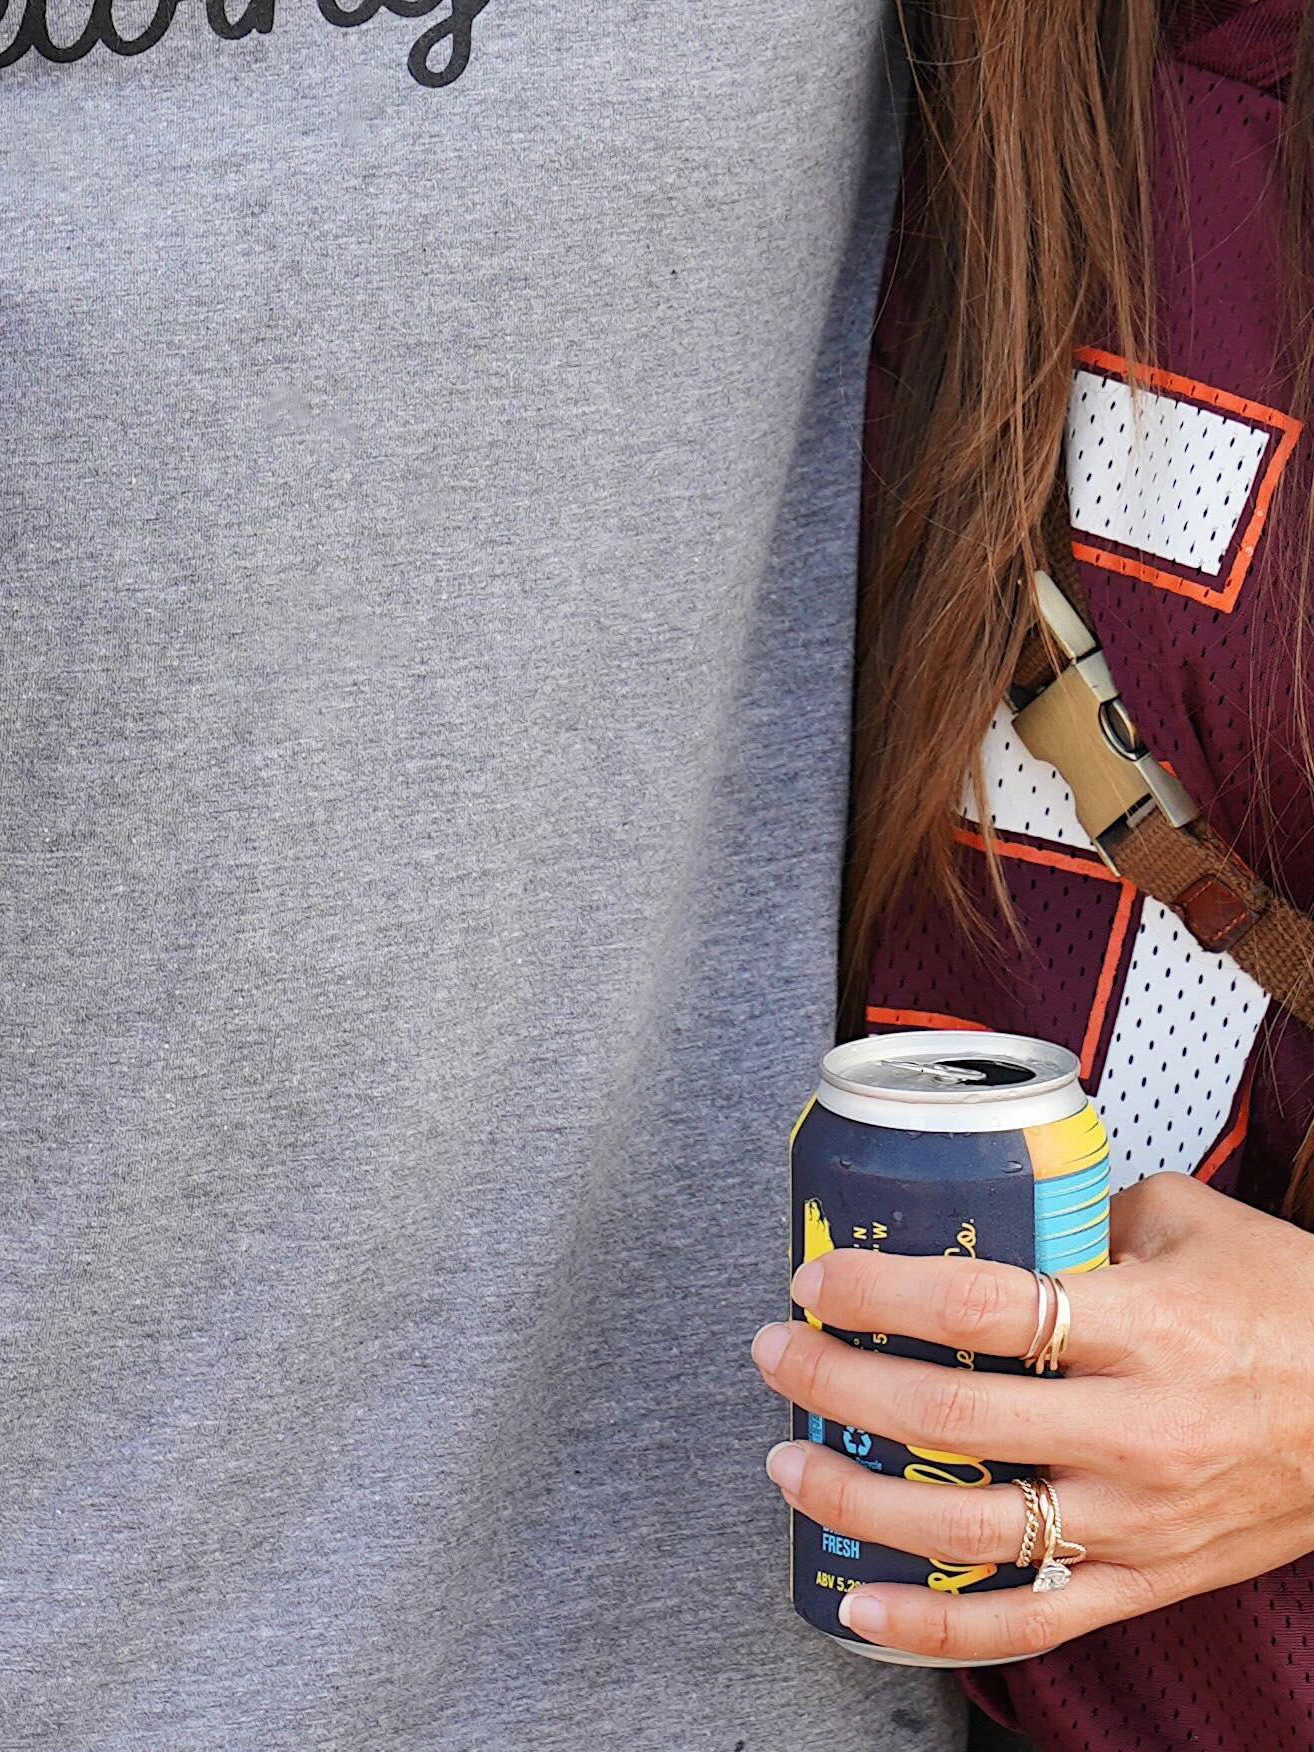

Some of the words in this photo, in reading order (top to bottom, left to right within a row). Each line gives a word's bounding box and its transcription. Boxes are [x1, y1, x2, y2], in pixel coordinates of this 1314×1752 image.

[822, 1533, 860, 1559] FRESH
[816, 1571, 835, 1589] ABV
[837, 1576, 866, 1594] 5.2
